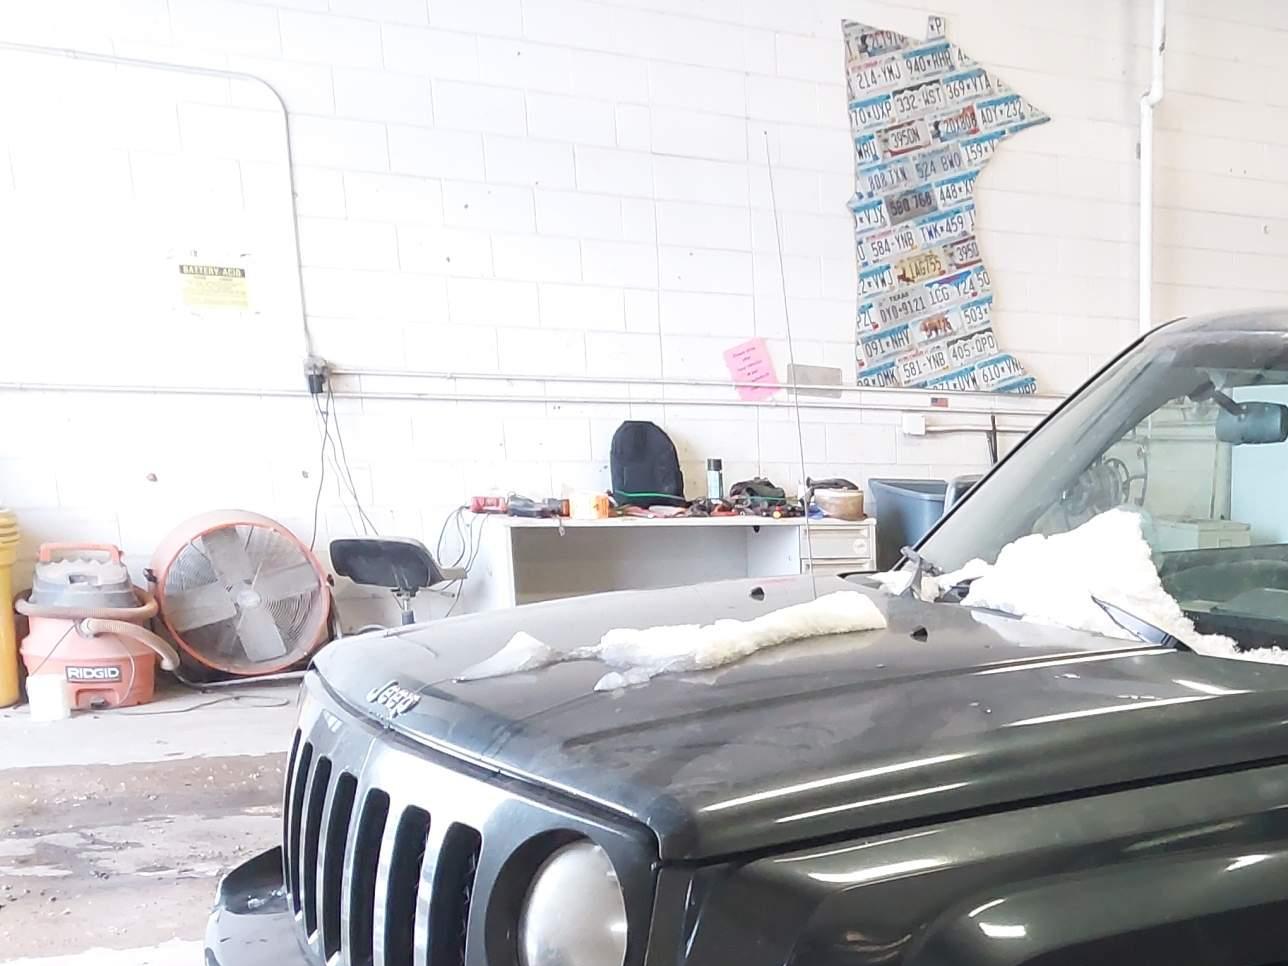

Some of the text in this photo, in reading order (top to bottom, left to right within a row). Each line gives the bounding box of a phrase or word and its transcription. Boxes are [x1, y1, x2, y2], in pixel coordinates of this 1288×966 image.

[182, 264, 242, 279] BATTERY ACID
[888, 291, 909, 302] TEXAS
[66, 667, 120, 680] RIDGID
